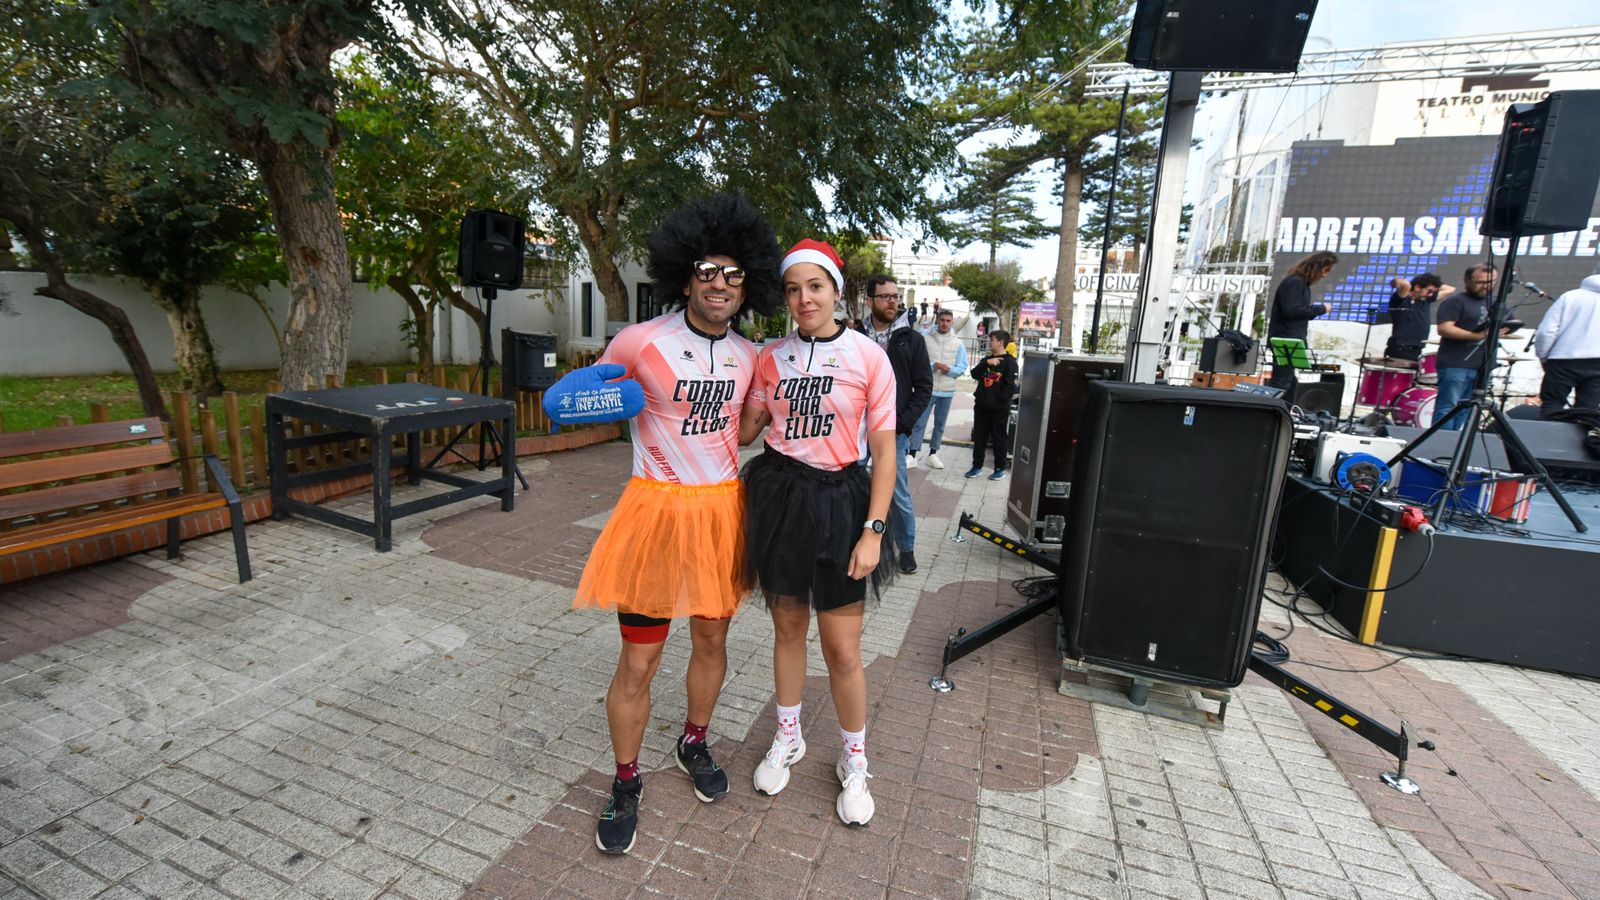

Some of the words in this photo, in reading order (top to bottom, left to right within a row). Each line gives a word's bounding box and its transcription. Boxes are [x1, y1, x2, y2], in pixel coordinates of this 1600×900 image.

[1417, 95, 1483, 108] TEATRO
[1276, 216, 1405, 253] ARRERA
[1412, 216, 1485, 255] SAN
[1490, 216, 1600, 256] ILVE
[1079, 275, 1141, 290] OFCINA
[673, 379, 736, 402] CORRO
[773, 375, 834, 400] CORRO
[575, 398, 624, 412] INFANTIL
[688, 401, 724, 421] POR
[789, 395, 822, 418] POR
[681, 415, 731, 436] ELLOS
[784, 413, 836, 441] ELLOS
